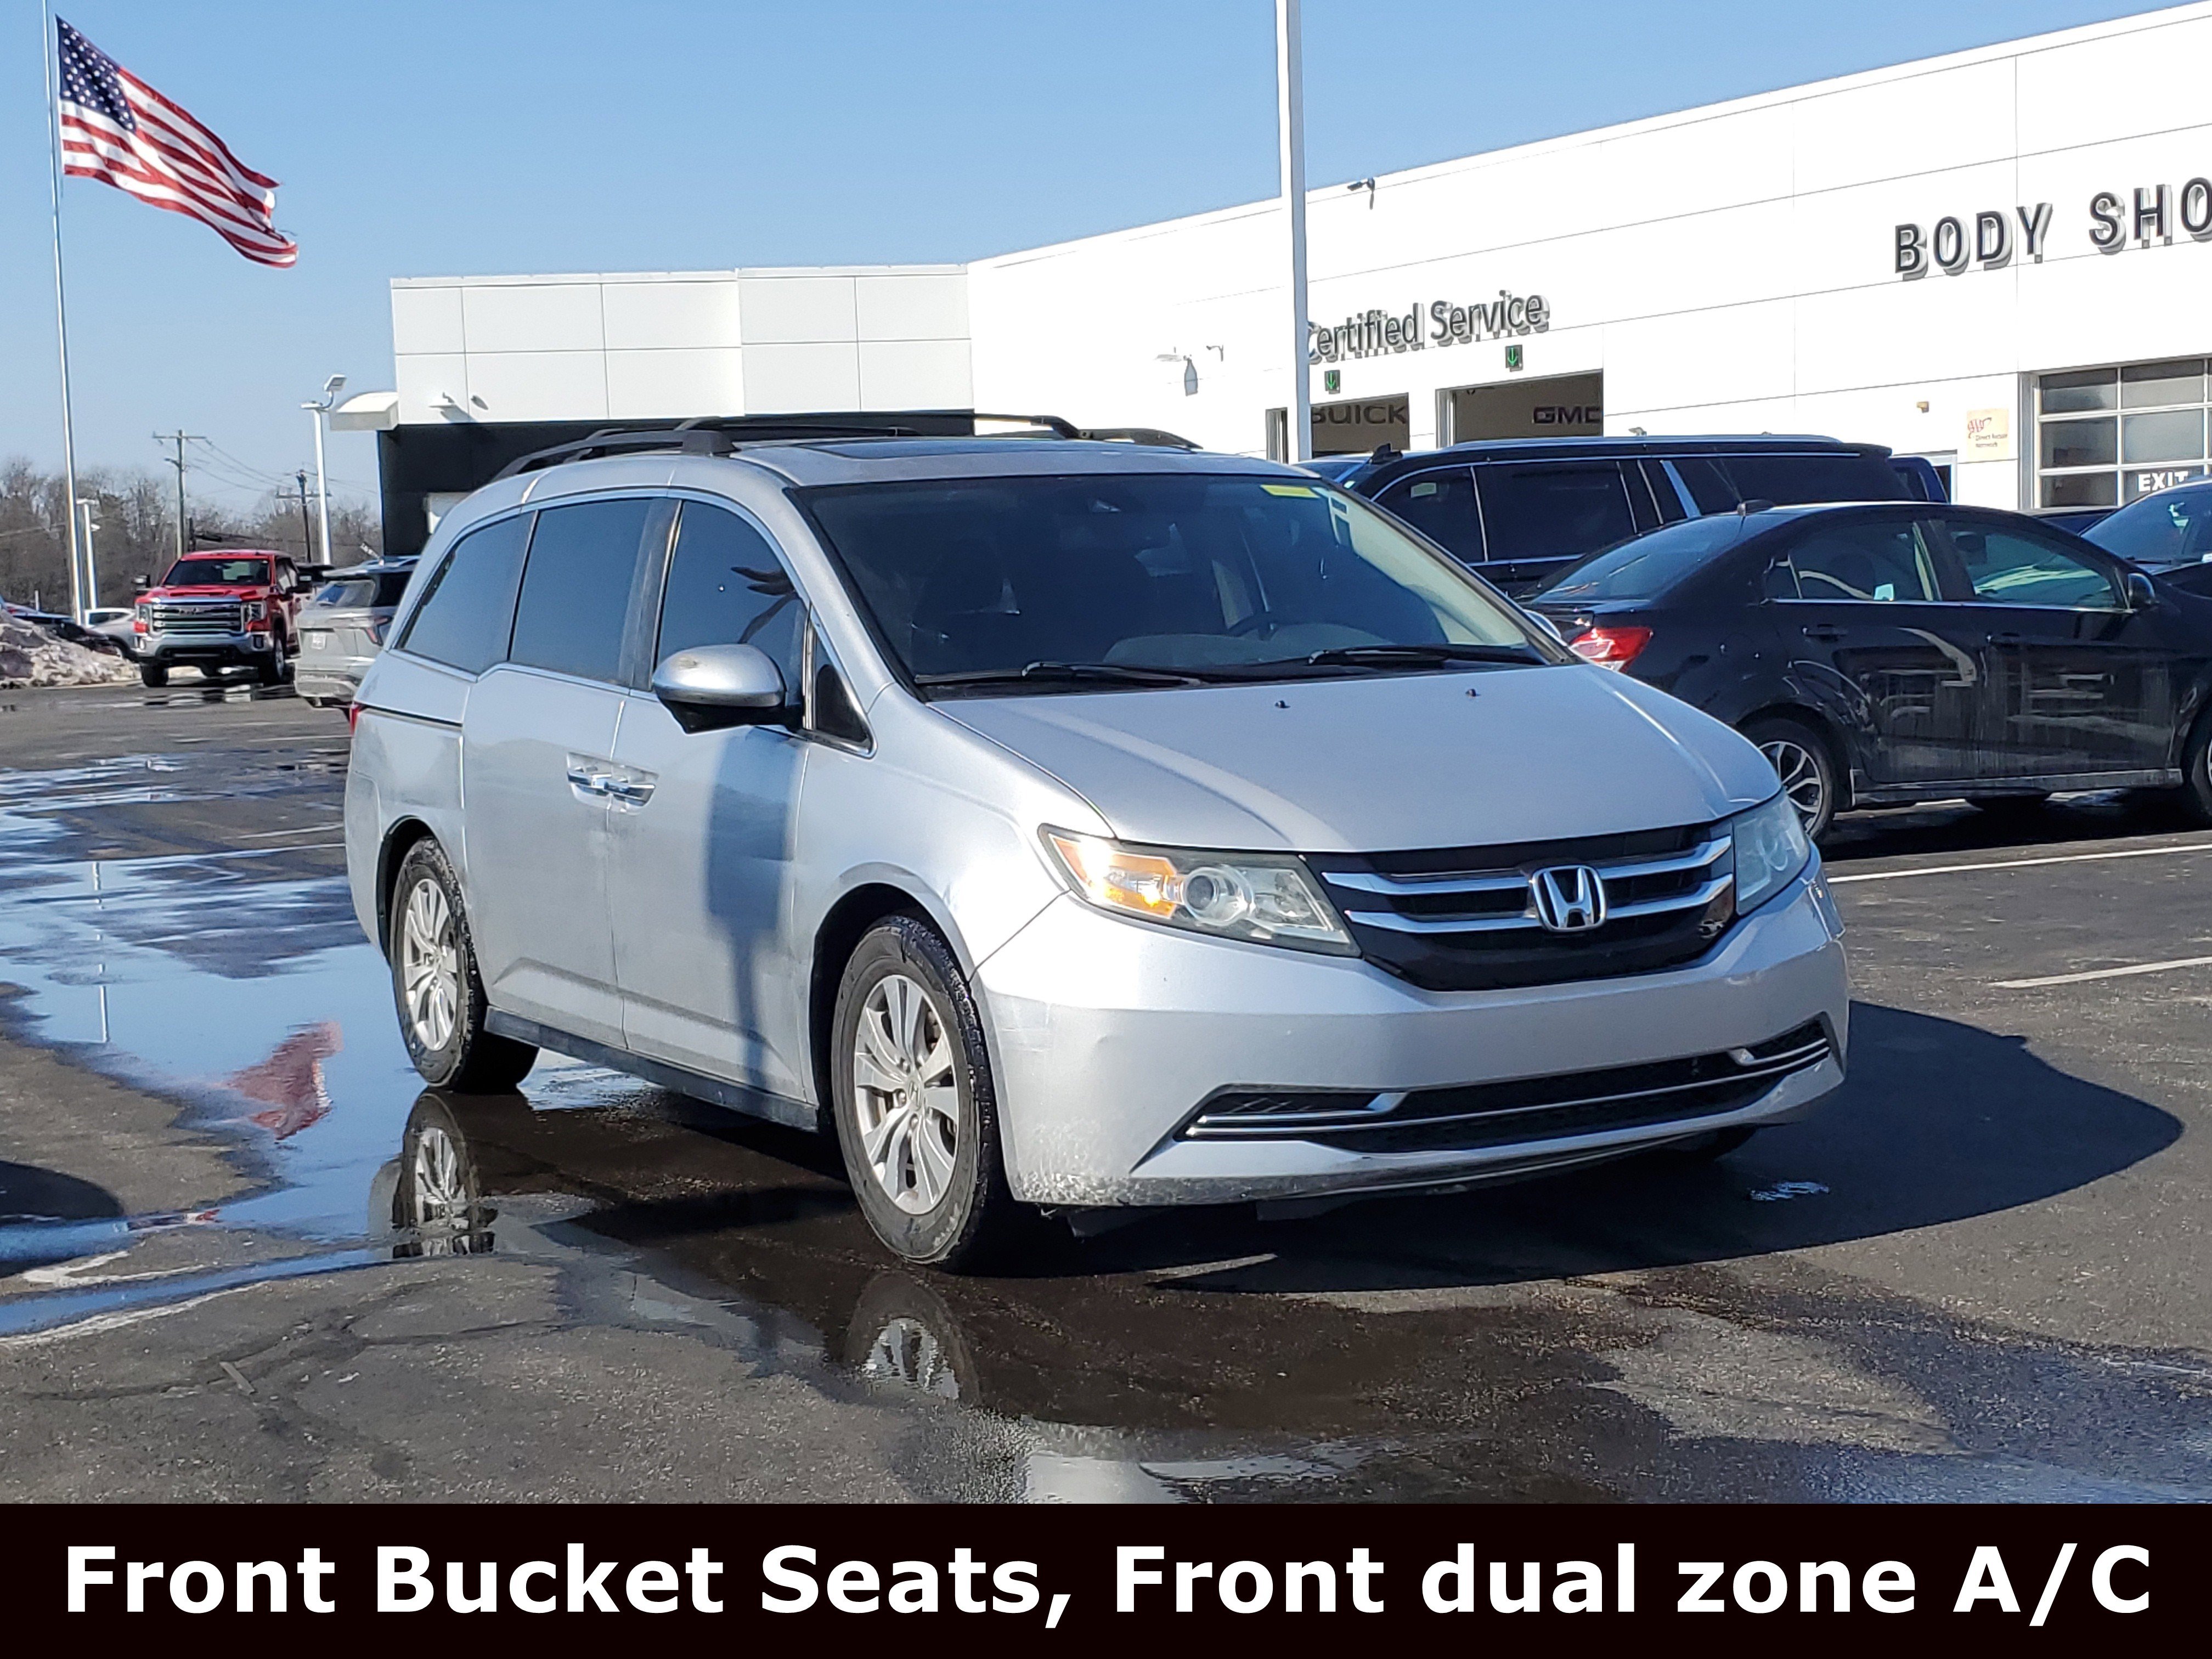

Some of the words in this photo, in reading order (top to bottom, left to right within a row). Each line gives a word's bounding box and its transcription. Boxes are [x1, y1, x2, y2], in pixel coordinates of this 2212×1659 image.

[1895, 202, 2051, 276] BODY
[2089, 177, 2212, 250] SHO
[1430, 290, 1547, 341] Service
[1534, 406, 1601, 424] GMC
[2138, 471, 2188, 492] EXIT
